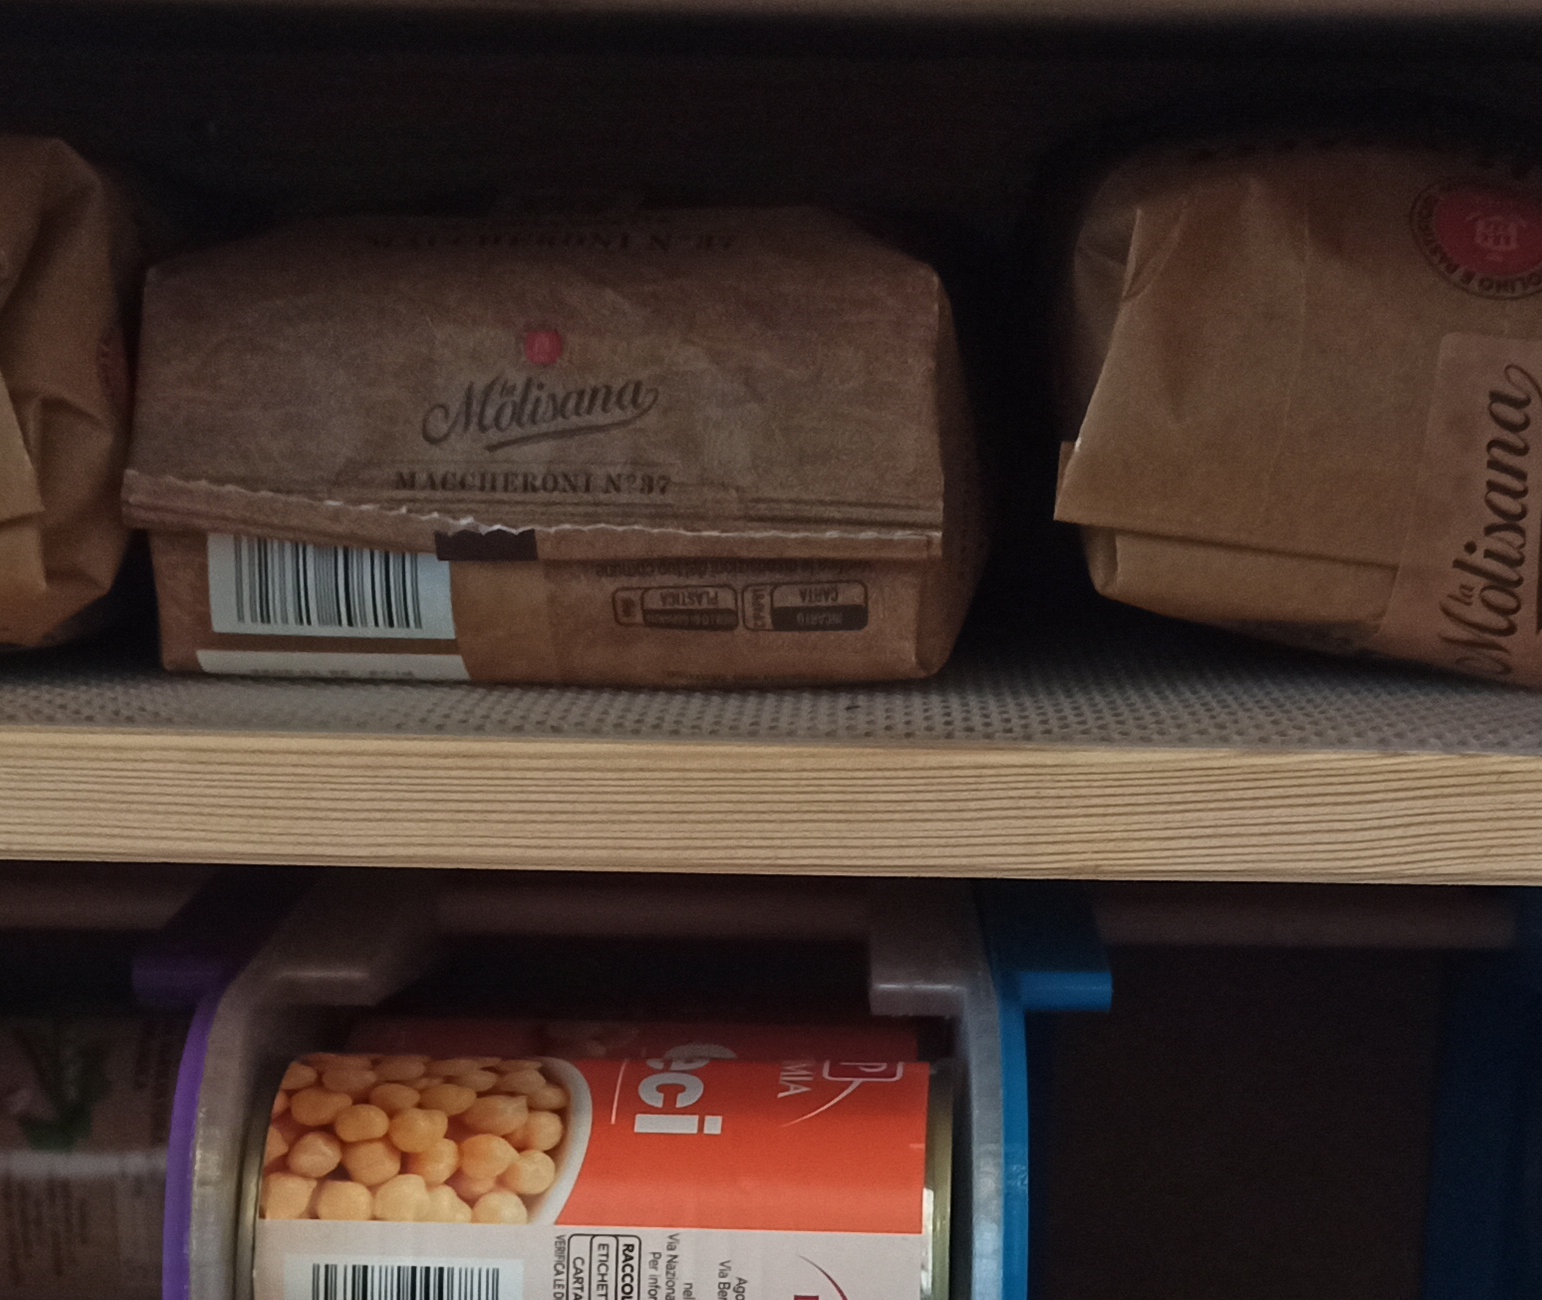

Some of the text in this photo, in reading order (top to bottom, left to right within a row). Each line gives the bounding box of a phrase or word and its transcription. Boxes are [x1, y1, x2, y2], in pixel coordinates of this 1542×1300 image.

[422, 376, 659, 452] Molisana
[394, 470, 594, 494] MACCHERONI
[660, 589, 719, 606] PLASTICA
[798, 588, 839, 604] CARTA
[777, 1062, 814, 1098] MIA
[667, 1233, 679, 1251] Via
[553, 1235, 565, 1276] VERIFICA
[648, 1252, 661, 1270] Per
[718, 1260, 731, 1279] Via
[553, 1279, 564, 1289] LE
